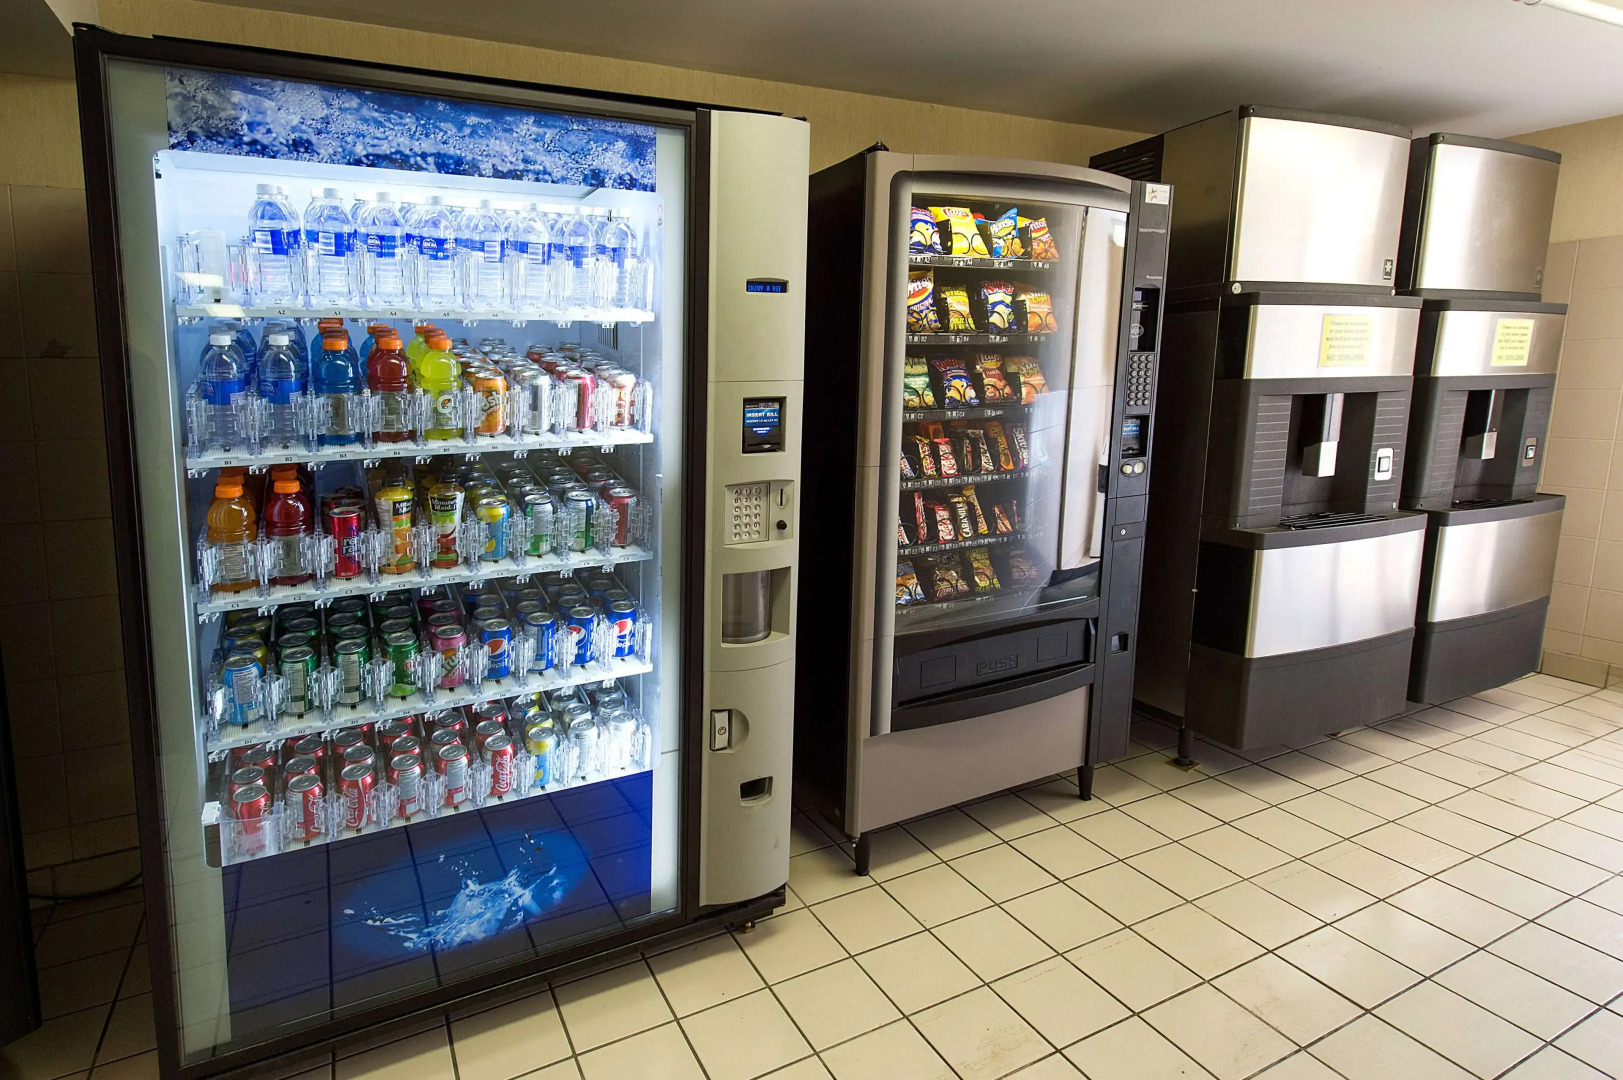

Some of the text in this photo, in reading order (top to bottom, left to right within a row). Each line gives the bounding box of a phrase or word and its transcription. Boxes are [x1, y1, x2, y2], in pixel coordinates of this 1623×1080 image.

[748, 284, 764, 292] ENJOY
[956, 502, 972, 538] CARAMILK
[979, 656, 1014, 674] PUSH
